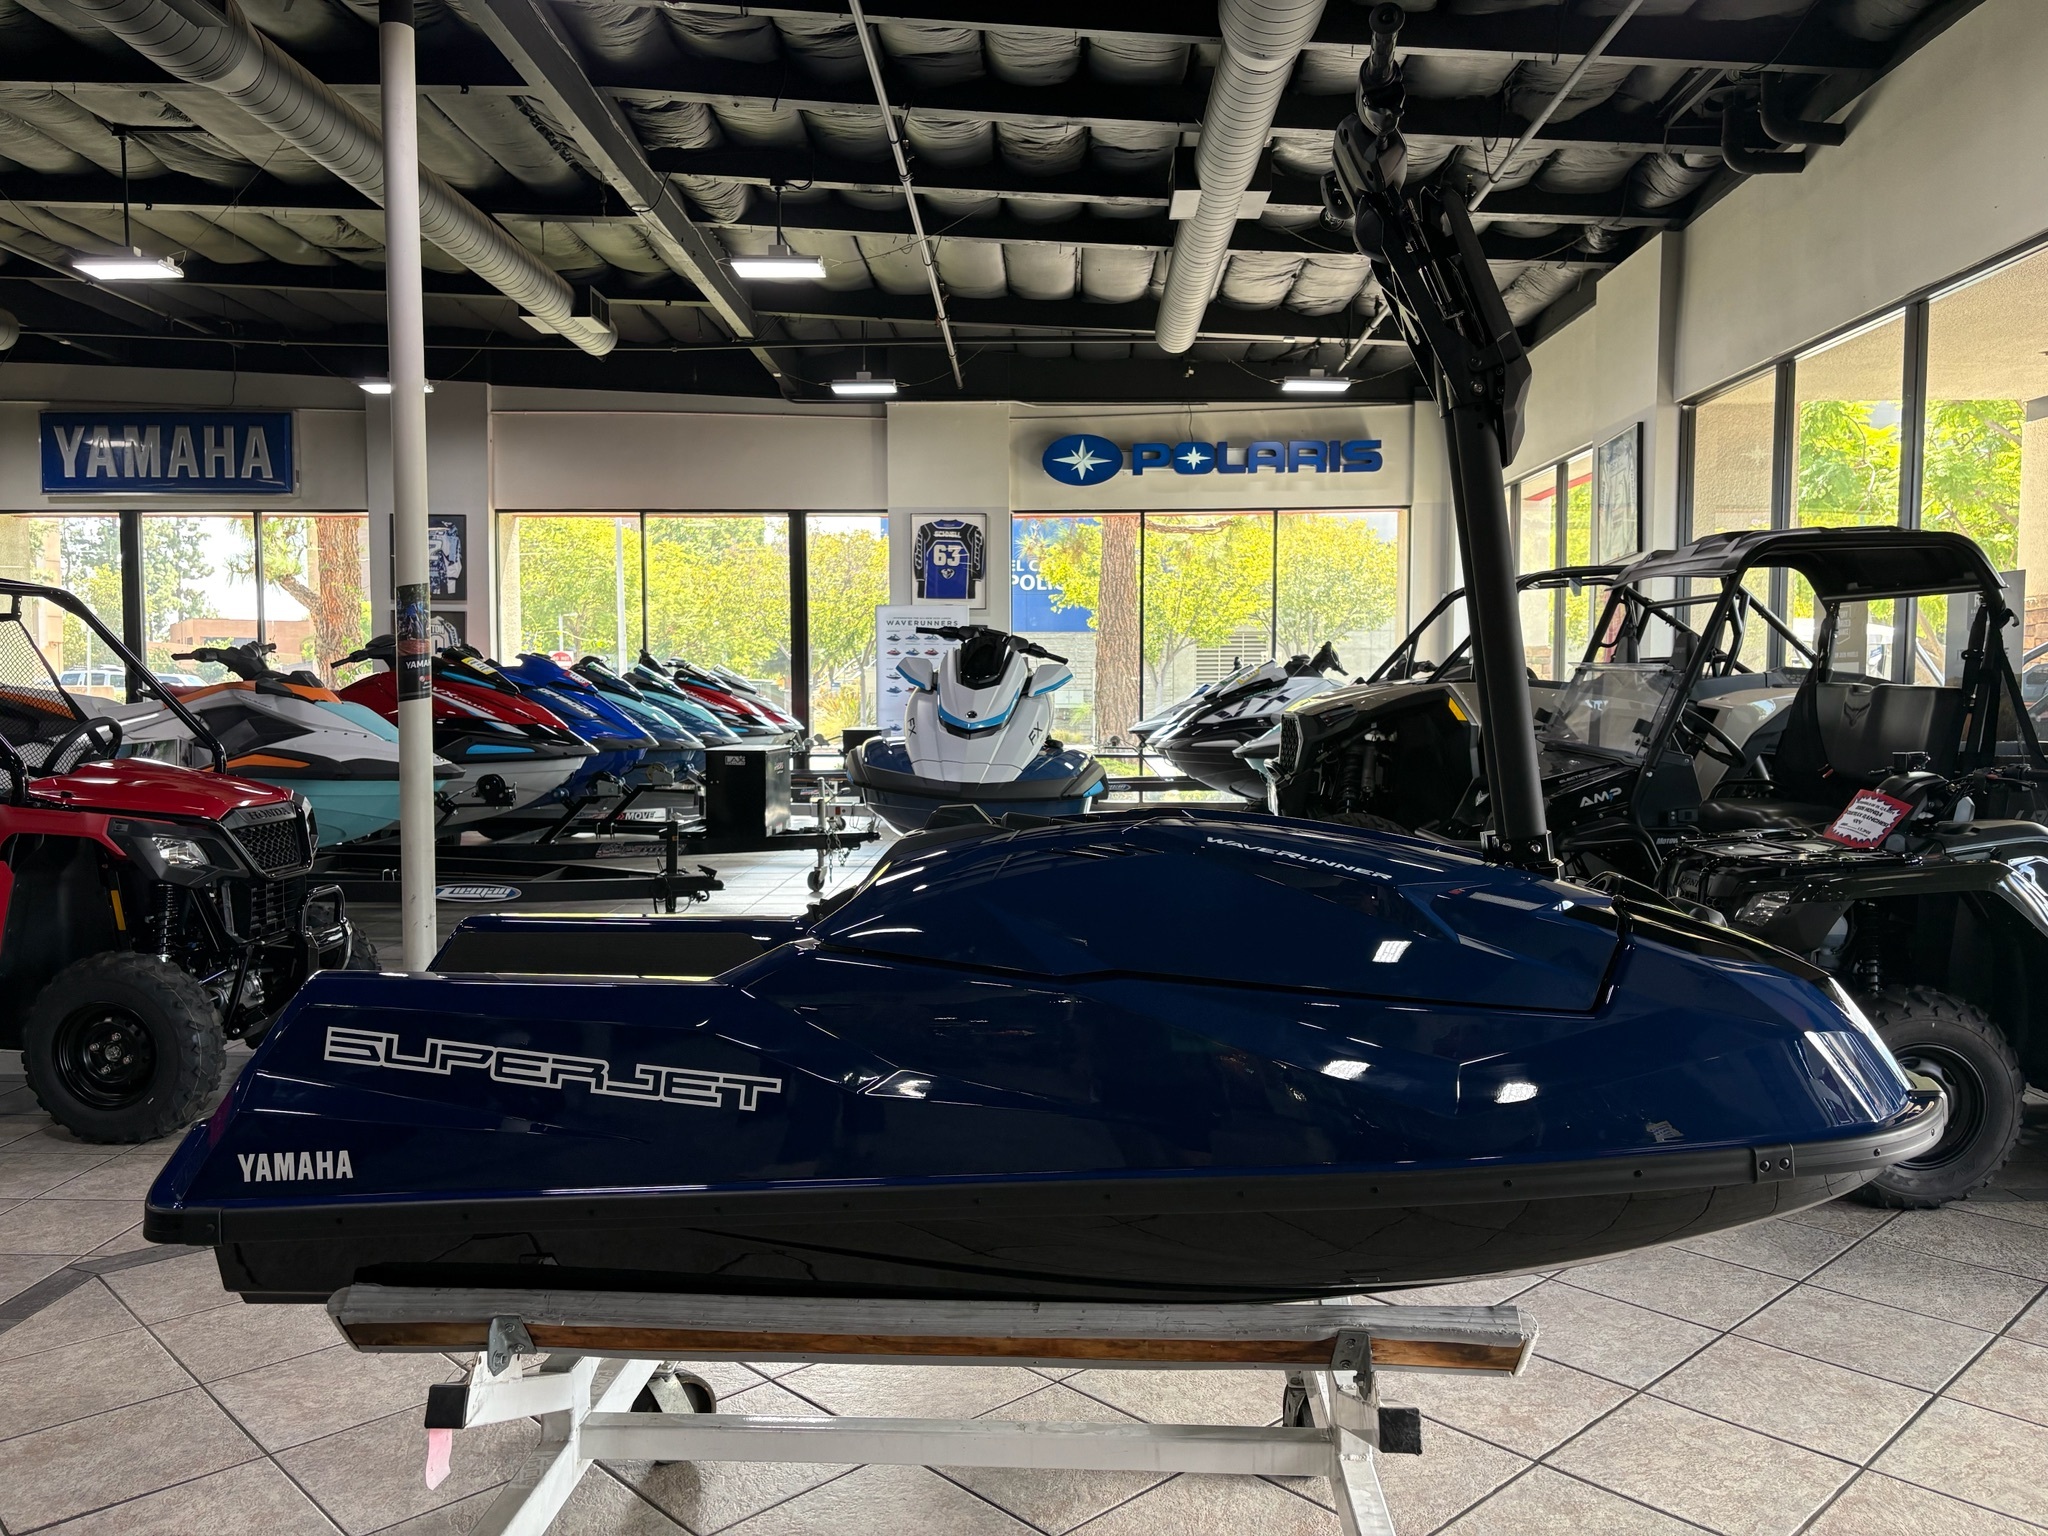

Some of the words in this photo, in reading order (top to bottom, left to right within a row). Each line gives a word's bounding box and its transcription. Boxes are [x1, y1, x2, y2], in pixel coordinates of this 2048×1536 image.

[53, 425, 274, 478] YAMAHA
[1132, 439, 1383, 476] POLARIS
[933, 544, 962, 567] 63
[907, 717, 917, 737] FX
[1028, 721, 1043, 746] FX
[246, 807, 292, 820] HONDA
[1207, 837, 1392, 880] WAVERUNNER
[324, 1026, 782, 1111] SUPERJET
[237, 1150, 353, 1182] YAMAHA
